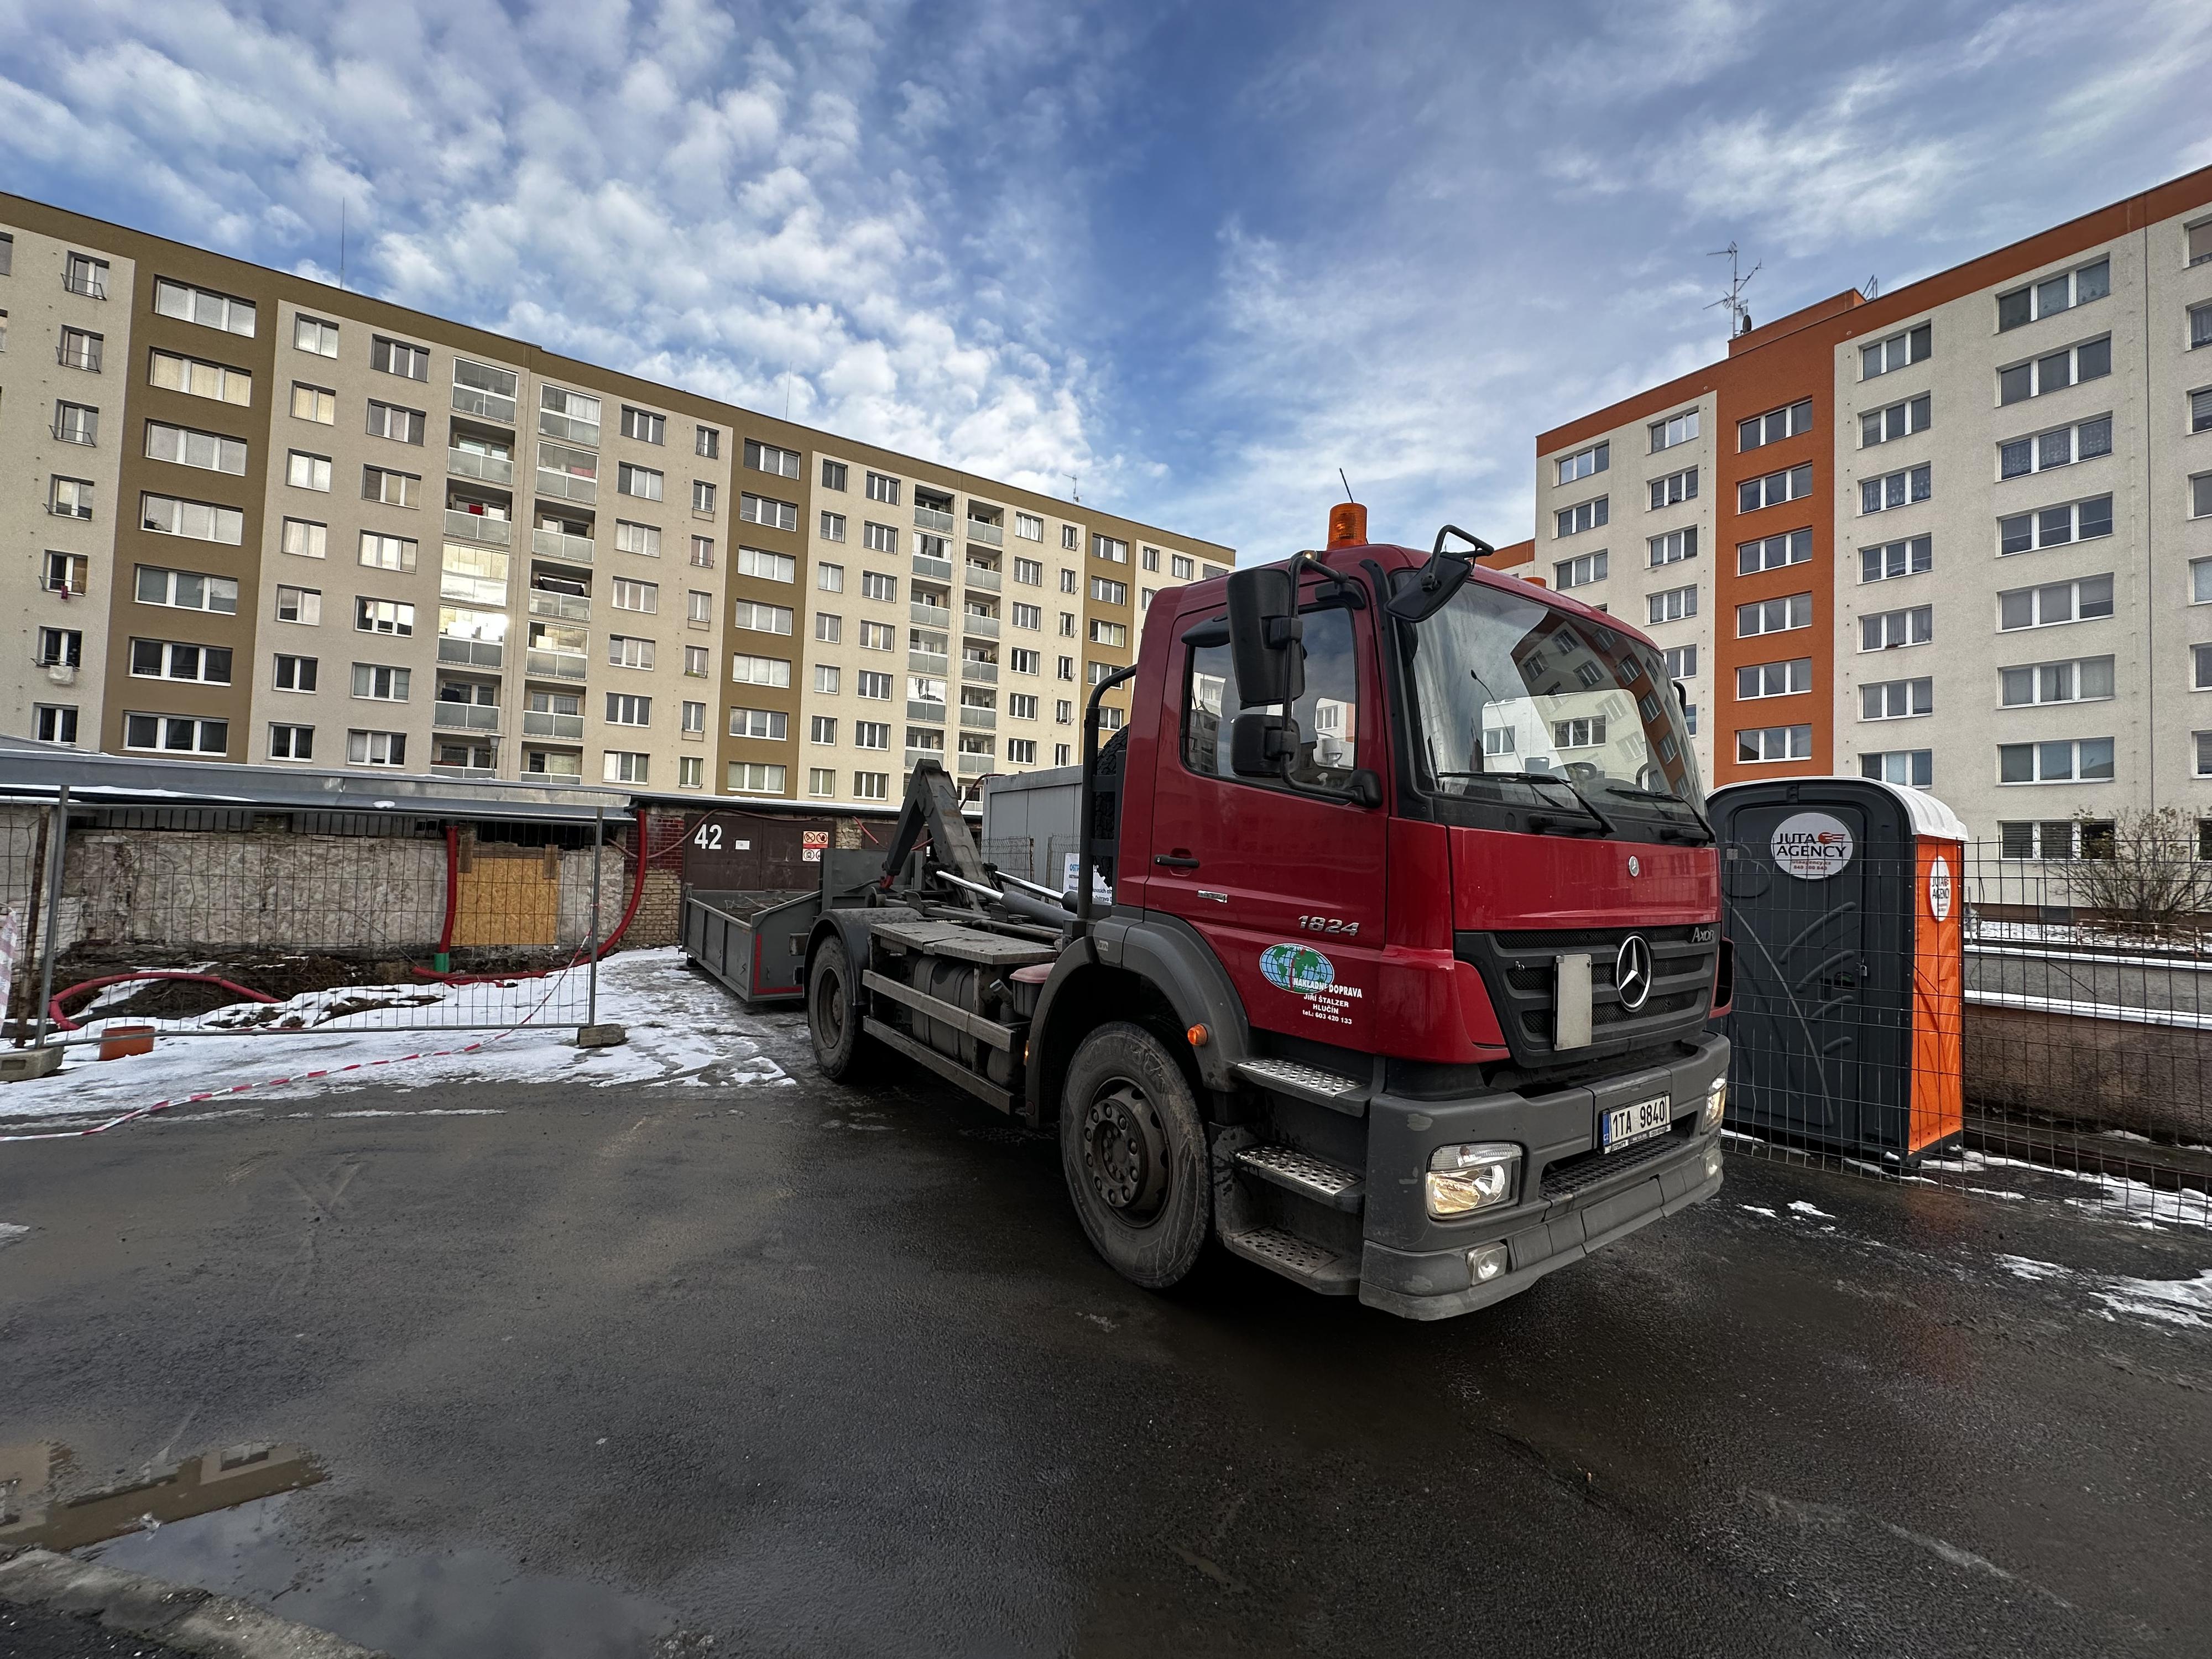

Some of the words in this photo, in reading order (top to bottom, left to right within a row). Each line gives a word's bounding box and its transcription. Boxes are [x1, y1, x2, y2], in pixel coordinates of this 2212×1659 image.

[695, 824, 722, 849] 42
[1777, 833, 1816, 844] JUTA
[1777, 846, 1846, 857] AGENCY
[1298, 915, 1359, 936] 1824
[1329, 984, 1363, 998] DOPRAVA
[1318, 995, 1349, 1008] ŠTALZER
[1313, 1003, 1339, 1014] HLUČÍN
[1613, 1110, 1632, 1138] 1TA
[1640, 1100, 1665, 1128] 9840
